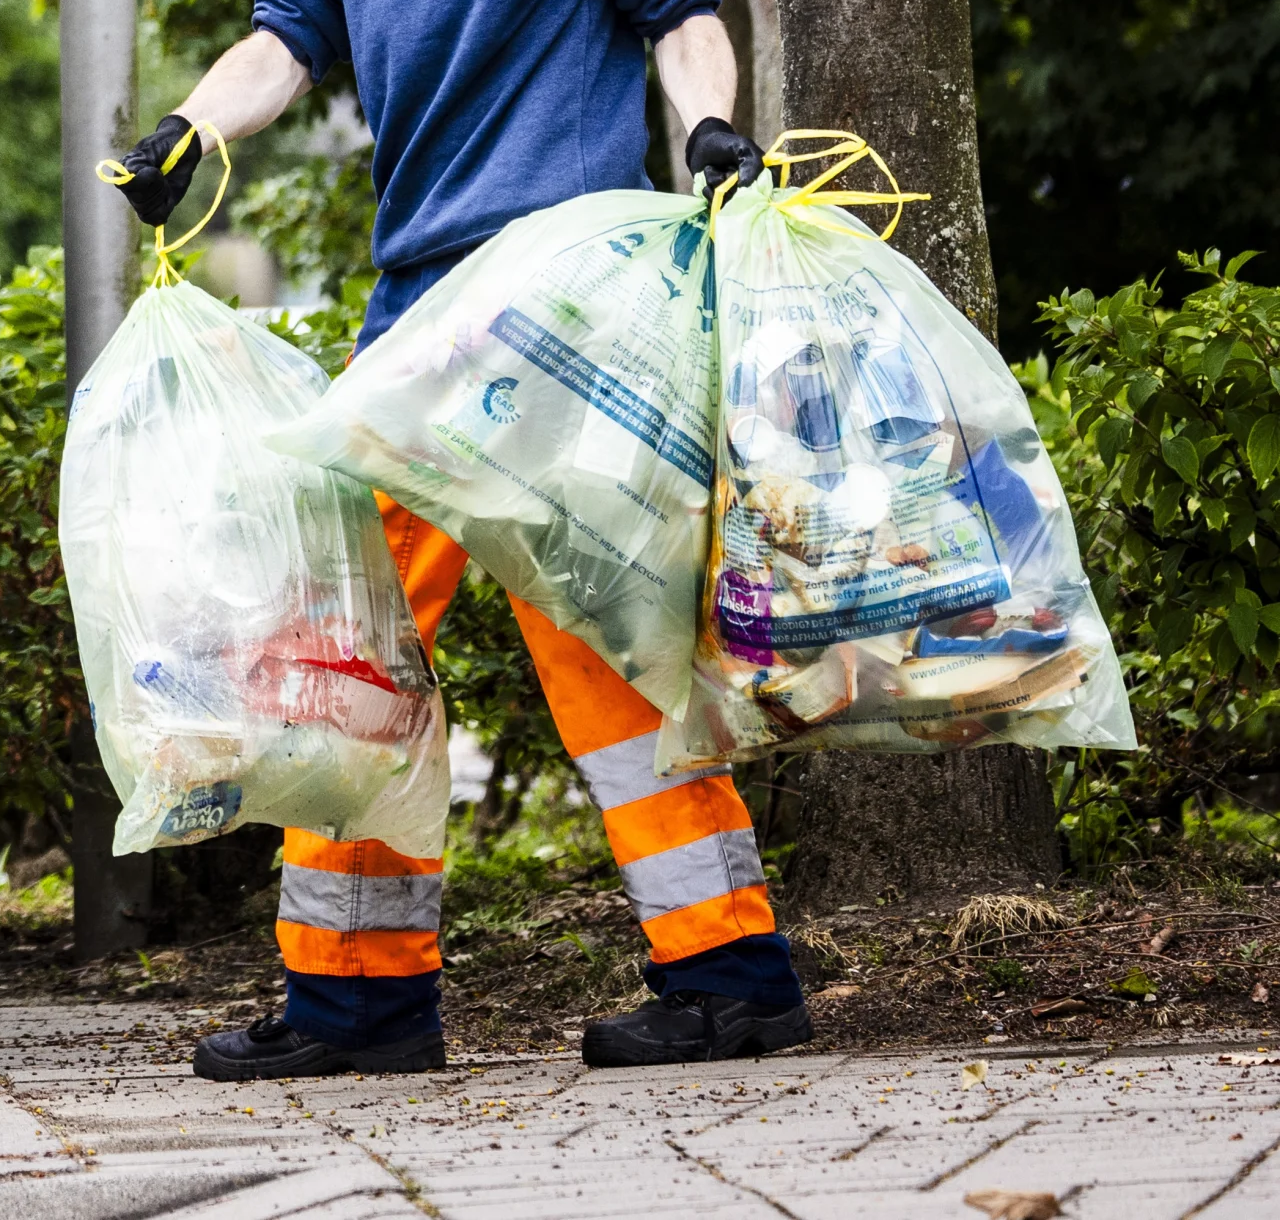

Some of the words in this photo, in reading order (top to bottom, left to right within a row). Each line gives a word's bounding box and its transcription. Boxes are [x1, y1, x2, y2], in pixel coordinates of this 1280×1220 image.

[509, 315, 543, 342] NIEUWE
[540, 337, 560, 354] ZAK
[559, 350, 592, 376] NODIG?
[590, 371, 603, 385] DE
[601, 380, 634, 407] ZAKKEN
[608, 354, 617, 364] U
[617, 360, 642, 381] hoeft
[640, 378, 651, 389] ze
[611, 338, 633, 360] Zorg
[632, 353, 649, 369] dat
[647, 364, 666, 380] alle
[493, 394, 515, 413] RAD
[500, 324, 566, 375] VERSCHILLENDE
[564, 369, 628, 419] AFHAALPUNTEN
[626, 414, 639, 427] EN
[670, 448, 688, 464] VAN
[685, 459, 697, 471] DE
[450, 434, 466, 447] ZAK
[465, 444, 474, 453] IS
[473, 449, 511, 477] GEMAAKT
[510, 473, 527, 488] VAN
[598, 538, 616, 553] HELP
[629, 560, 667, 588] RECYCLEN!
[804, 579, 829, 590] Zorg
[831, 575, 849, 585] dat
[851, 572, 869, 583] alle
[871, 553, 938, 579] verpakkingen
[963, 537, 983, 552] zijn!
[813, 594, 820, 603] U
[823, 589, 851, 601] hoeft
[854, 589, 865, 597] ze
[868, 581, 888, 593] niet
[890, 571, 926, 588] schoon
[927, 567, 938, 577] te
[940, 554, 981, 573] spoelen.
[774, 619, 810, 629] NODIG?
[811, 618, 824, 627] DE
[826, 611, 864, 625] ZAKKEN
[866, 606, 886, 618] ZIJN
[888, 602, 907, 613] O.A.
[977, 577, 991, 588] BIJ
[792, 623, 867, 642] AFHAALPUNTEN
[869, 620, 883, 630] EN
[883, 616, 898, 627] BIJ
[899, 613, 912, 623] DE
[912, 606, 939, 621] BALIE
[940, 600, 959, 612] VAN
[961, 596, 974, 606] DE
[975, 589, 995, 601] RAD
[909, 653, 987, 680] WWW.RADBV.NL
[985, 693, 1031, 711] RECYCLEN!
[172, 806, 224, 831] Oven
